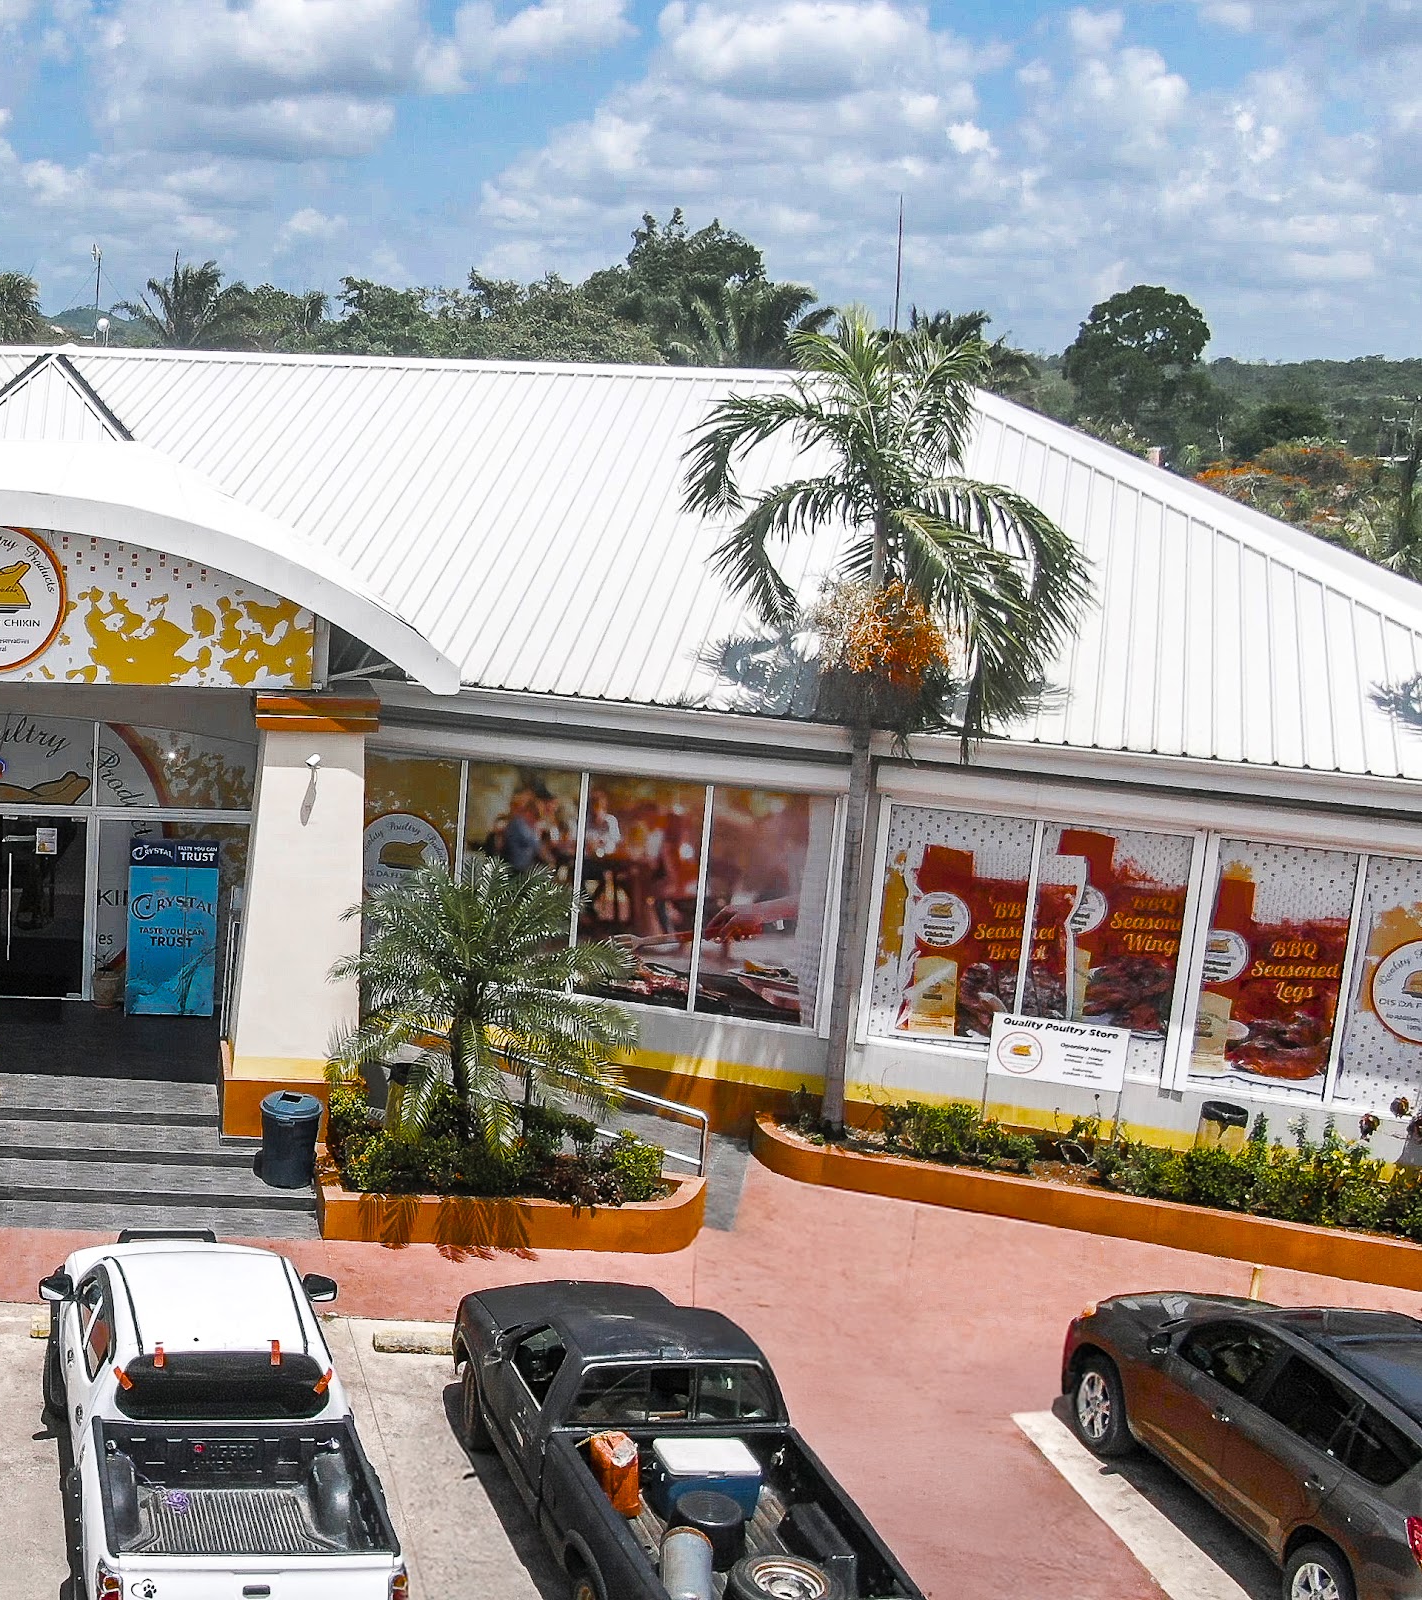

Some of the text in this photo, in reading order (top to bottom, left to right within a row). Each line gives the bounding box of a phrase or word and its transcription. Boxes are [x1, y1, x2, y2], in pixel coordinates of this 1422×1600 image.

[26, 545, 55, 594] Products
[4, 619, 41, 627] CHIKIN
[180, 852, 215, 862] TRUST
[131, 892, 216, 921] CRYSTAL
[993, 900, 1025, 919] BB
[139, 926, 205, 937] TASTE YOU CAN
[150, 935, 194, 948] TRUST
[1123, 933, 1178, 957] Wing
[1269, 940, 1318, 959] BBQ
[1250, 960, 1340, 979] Seasoned
[1274, 981, 1315, 1003] Legs
[1003, 1017, 1119, 1040] Quality Poultry Store
